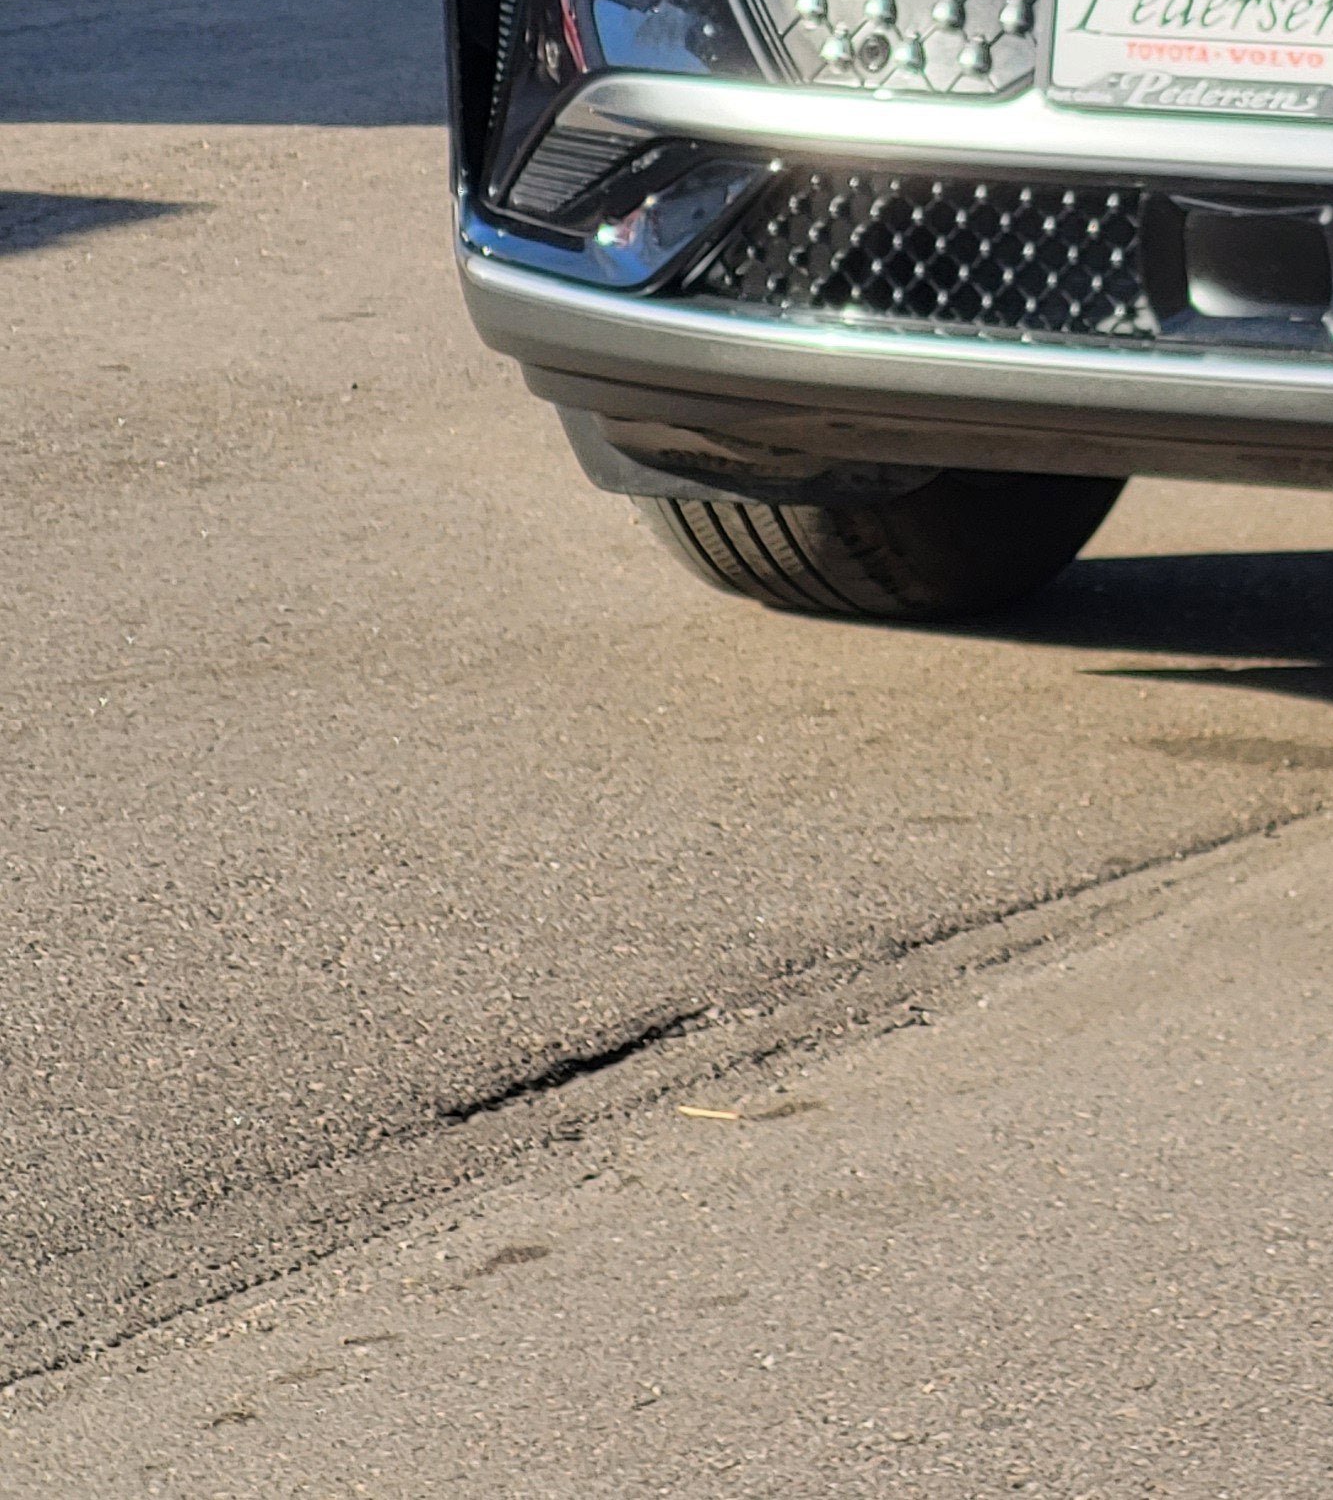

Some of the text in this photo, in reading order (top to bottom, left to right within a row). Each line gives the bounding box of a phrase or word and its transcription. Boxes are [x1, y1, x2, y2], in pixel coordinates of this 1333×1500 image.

[1126, 41, 1325, 68] TOYOTA VOLVO
[1108, 70, 1319, 112] Pedersen
